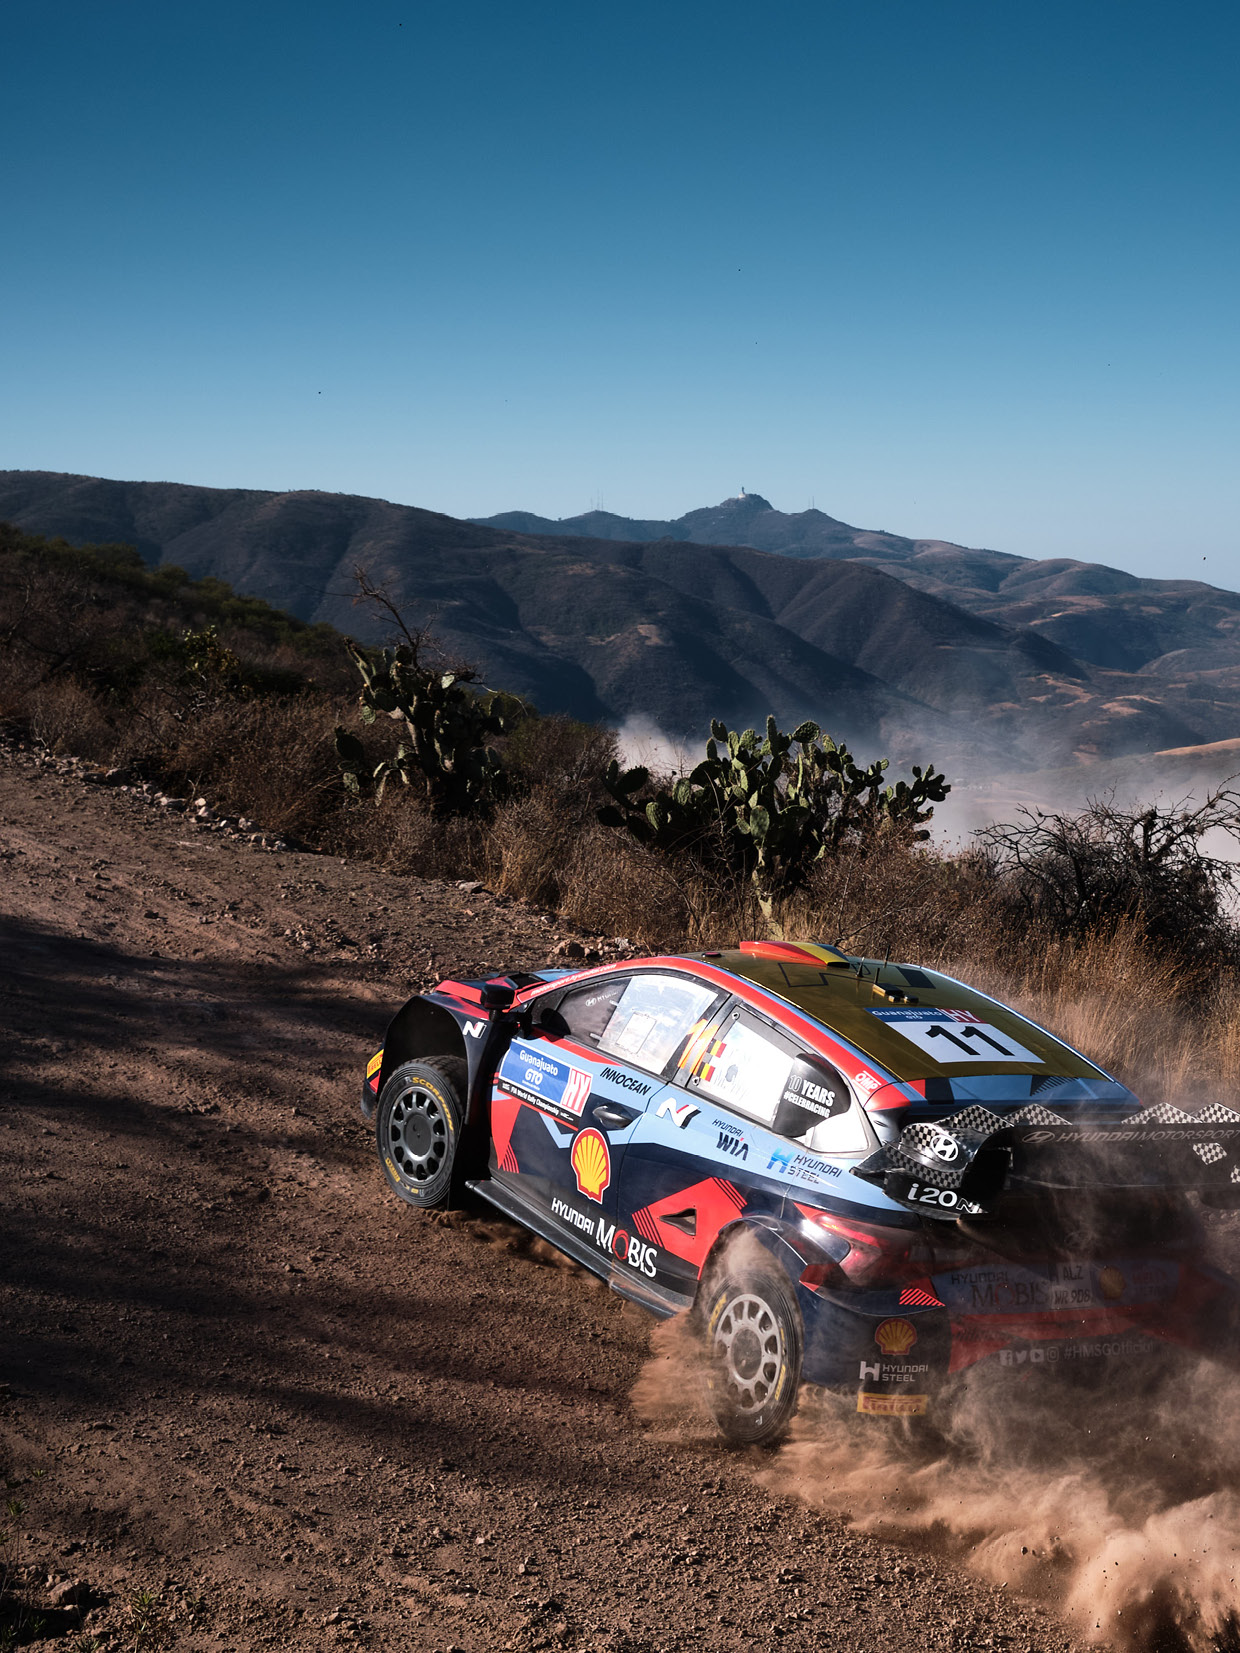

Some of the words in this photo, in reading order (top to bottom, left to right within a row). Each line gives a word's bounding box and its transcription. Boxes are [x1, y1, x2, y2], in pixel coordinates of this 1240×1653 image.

[872, 1009, 943, 1017] Guanajuato
[941, 1008, 981, 1023] HY
[925, 1024, 1016, 1057] 11
[519, 1049, 559, 1076] Guanajuato
[561, 1069, 592, 1114] HY
[525, 1068, 543, 1085] GTO
[600, 1067, 651, 1096] INNOCEAN
[855, 1072, 878, 1090] OMP
[517, 1088, 528, 1099] World
[788, 1074, 802, 1092] 10
[801, 1079, 835, 1107] YEARS
[412, 1076, 454, 1132] SCORPION
[712, 1118, 744, 1137] HYUNDAI
[1056, 1131, 1140, 1143] HYUNDAI
[787, 1165, 820, 1185] STEEL
[794, 1154, 843, 1178] HYUNDAI
[907, 1182, 958, 1208] i20
[551, 1197, 595, 1236] HYUNDAI
[595, 1217, 658, 1278] MOBIS
[951, 1269, 1009, 1285] HYUNDAI
[1063, 1265, 1084, 1280] ALZ
[971, 1280, 1048, 1308] MOBIS
[1064, 1340, 1154, 1360] #HMSGOfficial
[881, 1373, 916, 1382] STEEL
[882, 1364, 929, 1373] HYUNDAI
